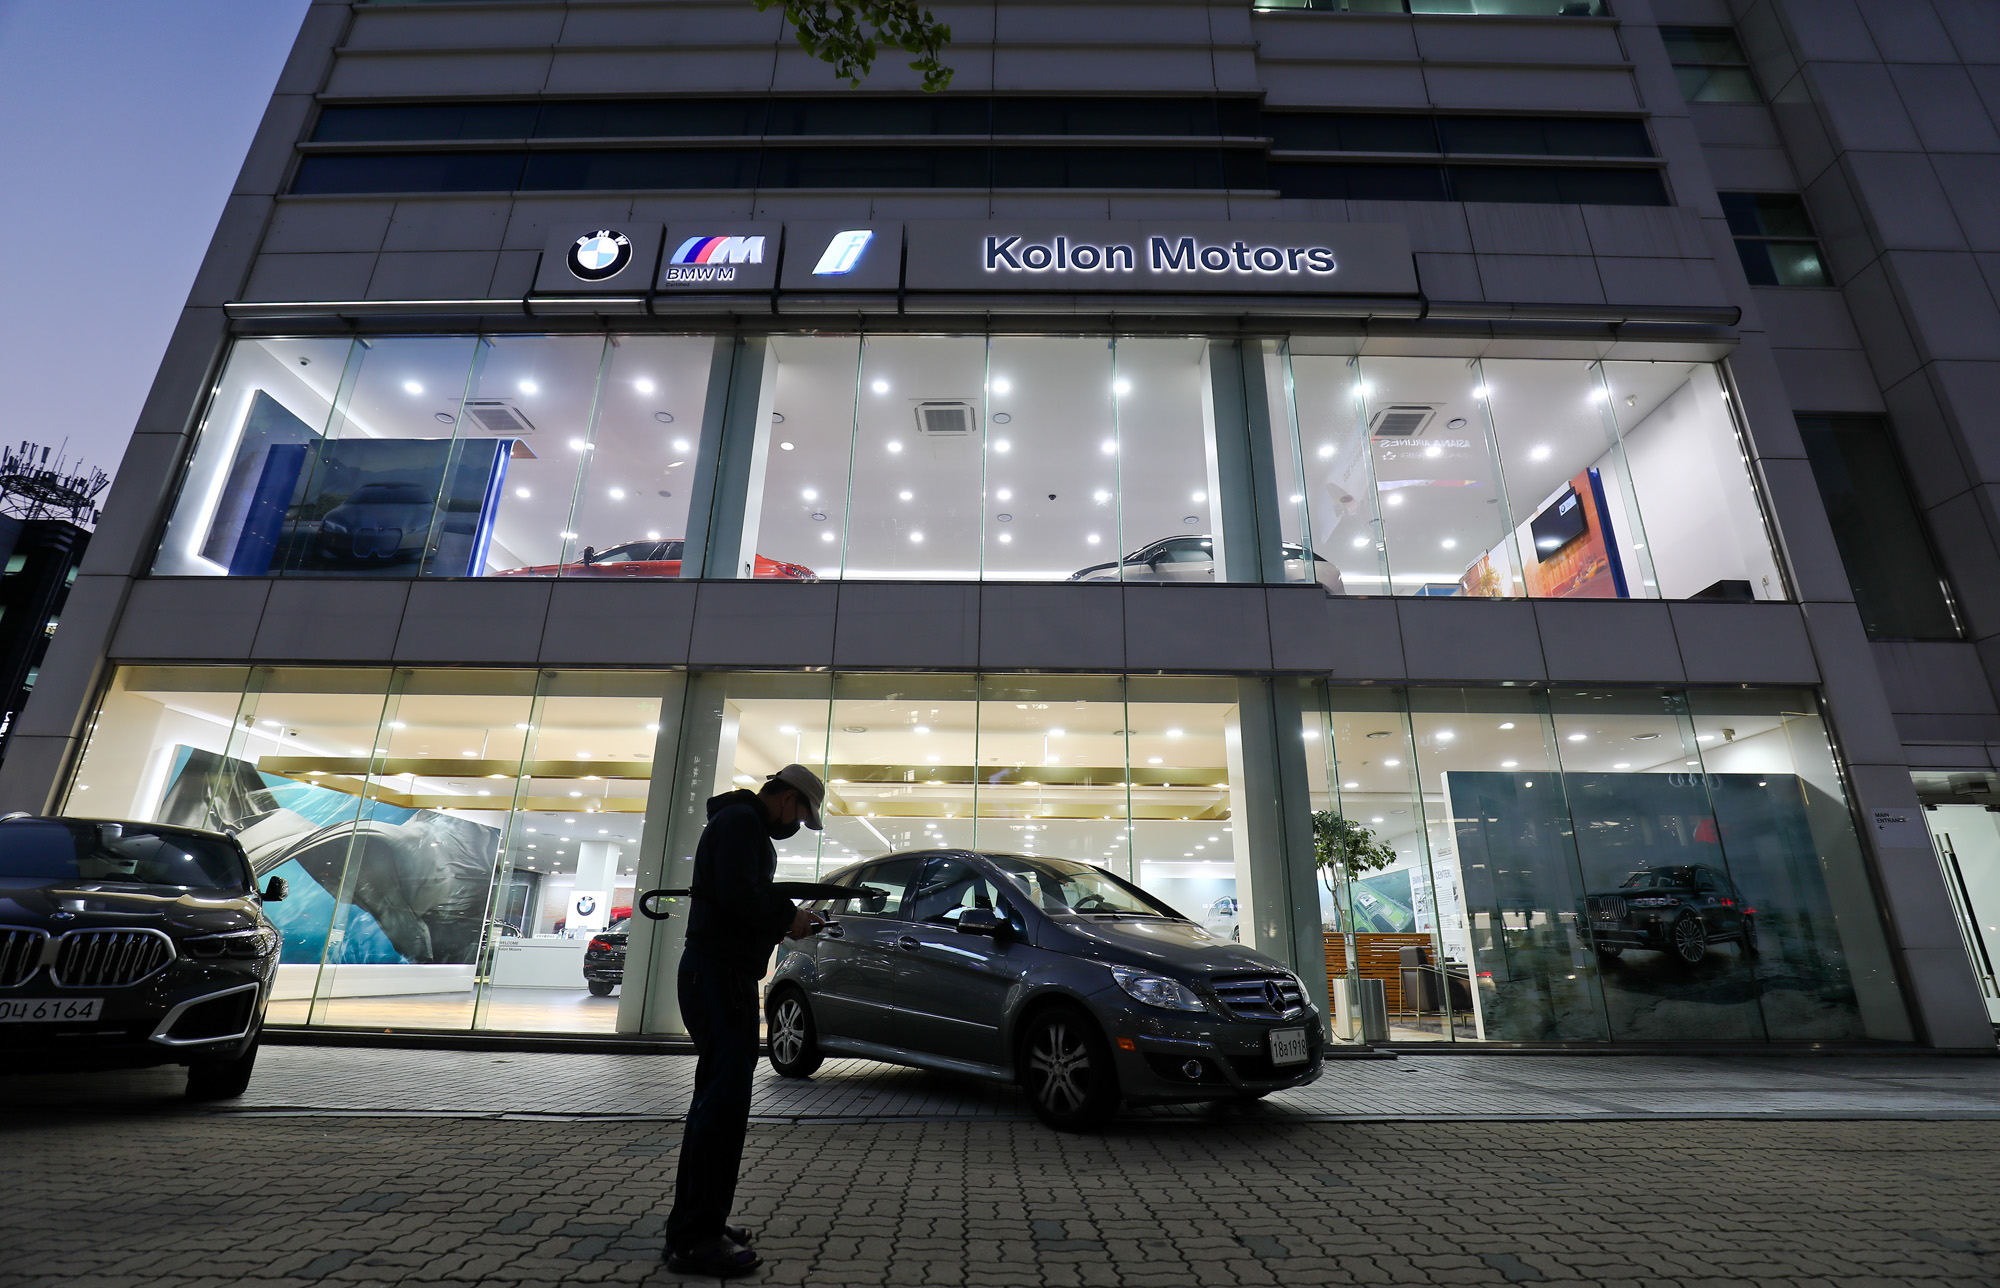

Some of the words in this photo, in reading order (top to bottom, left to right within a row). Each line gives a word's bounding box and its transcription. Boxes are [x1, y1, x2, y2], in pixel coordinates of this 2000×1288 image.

[985, 236, 1134, 270] Kolon
[1150, 237, 1336, 273] Motors
[665, 267, 714, 282] BMW
[717, 266, 736, 282] M
[33, 1000, 95, 1019] 6164
